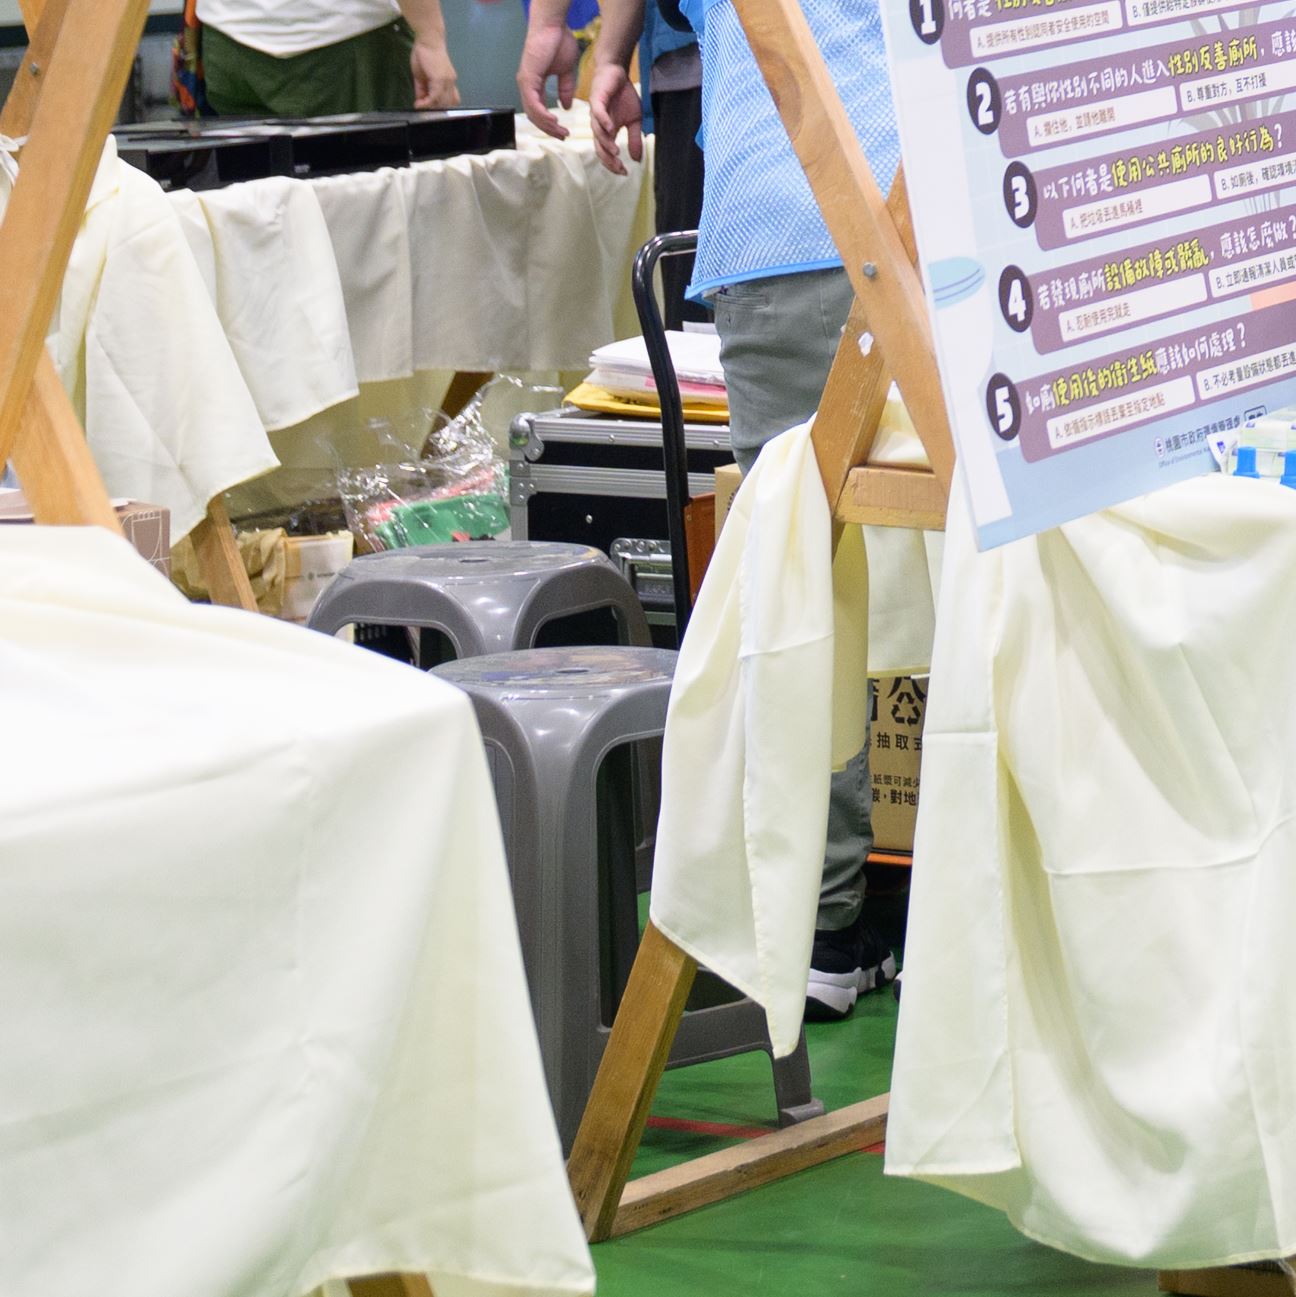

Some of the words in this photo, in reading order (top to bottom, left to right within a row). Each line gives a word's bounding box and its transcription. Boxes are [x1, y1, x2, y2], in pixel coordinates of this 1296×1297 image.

[975, 81, 994, 126] 2
[1011, 175, 1030, 220] 3
[1008, 279, 1026, 322] 4
[995, 386, 1014, 432] 5
